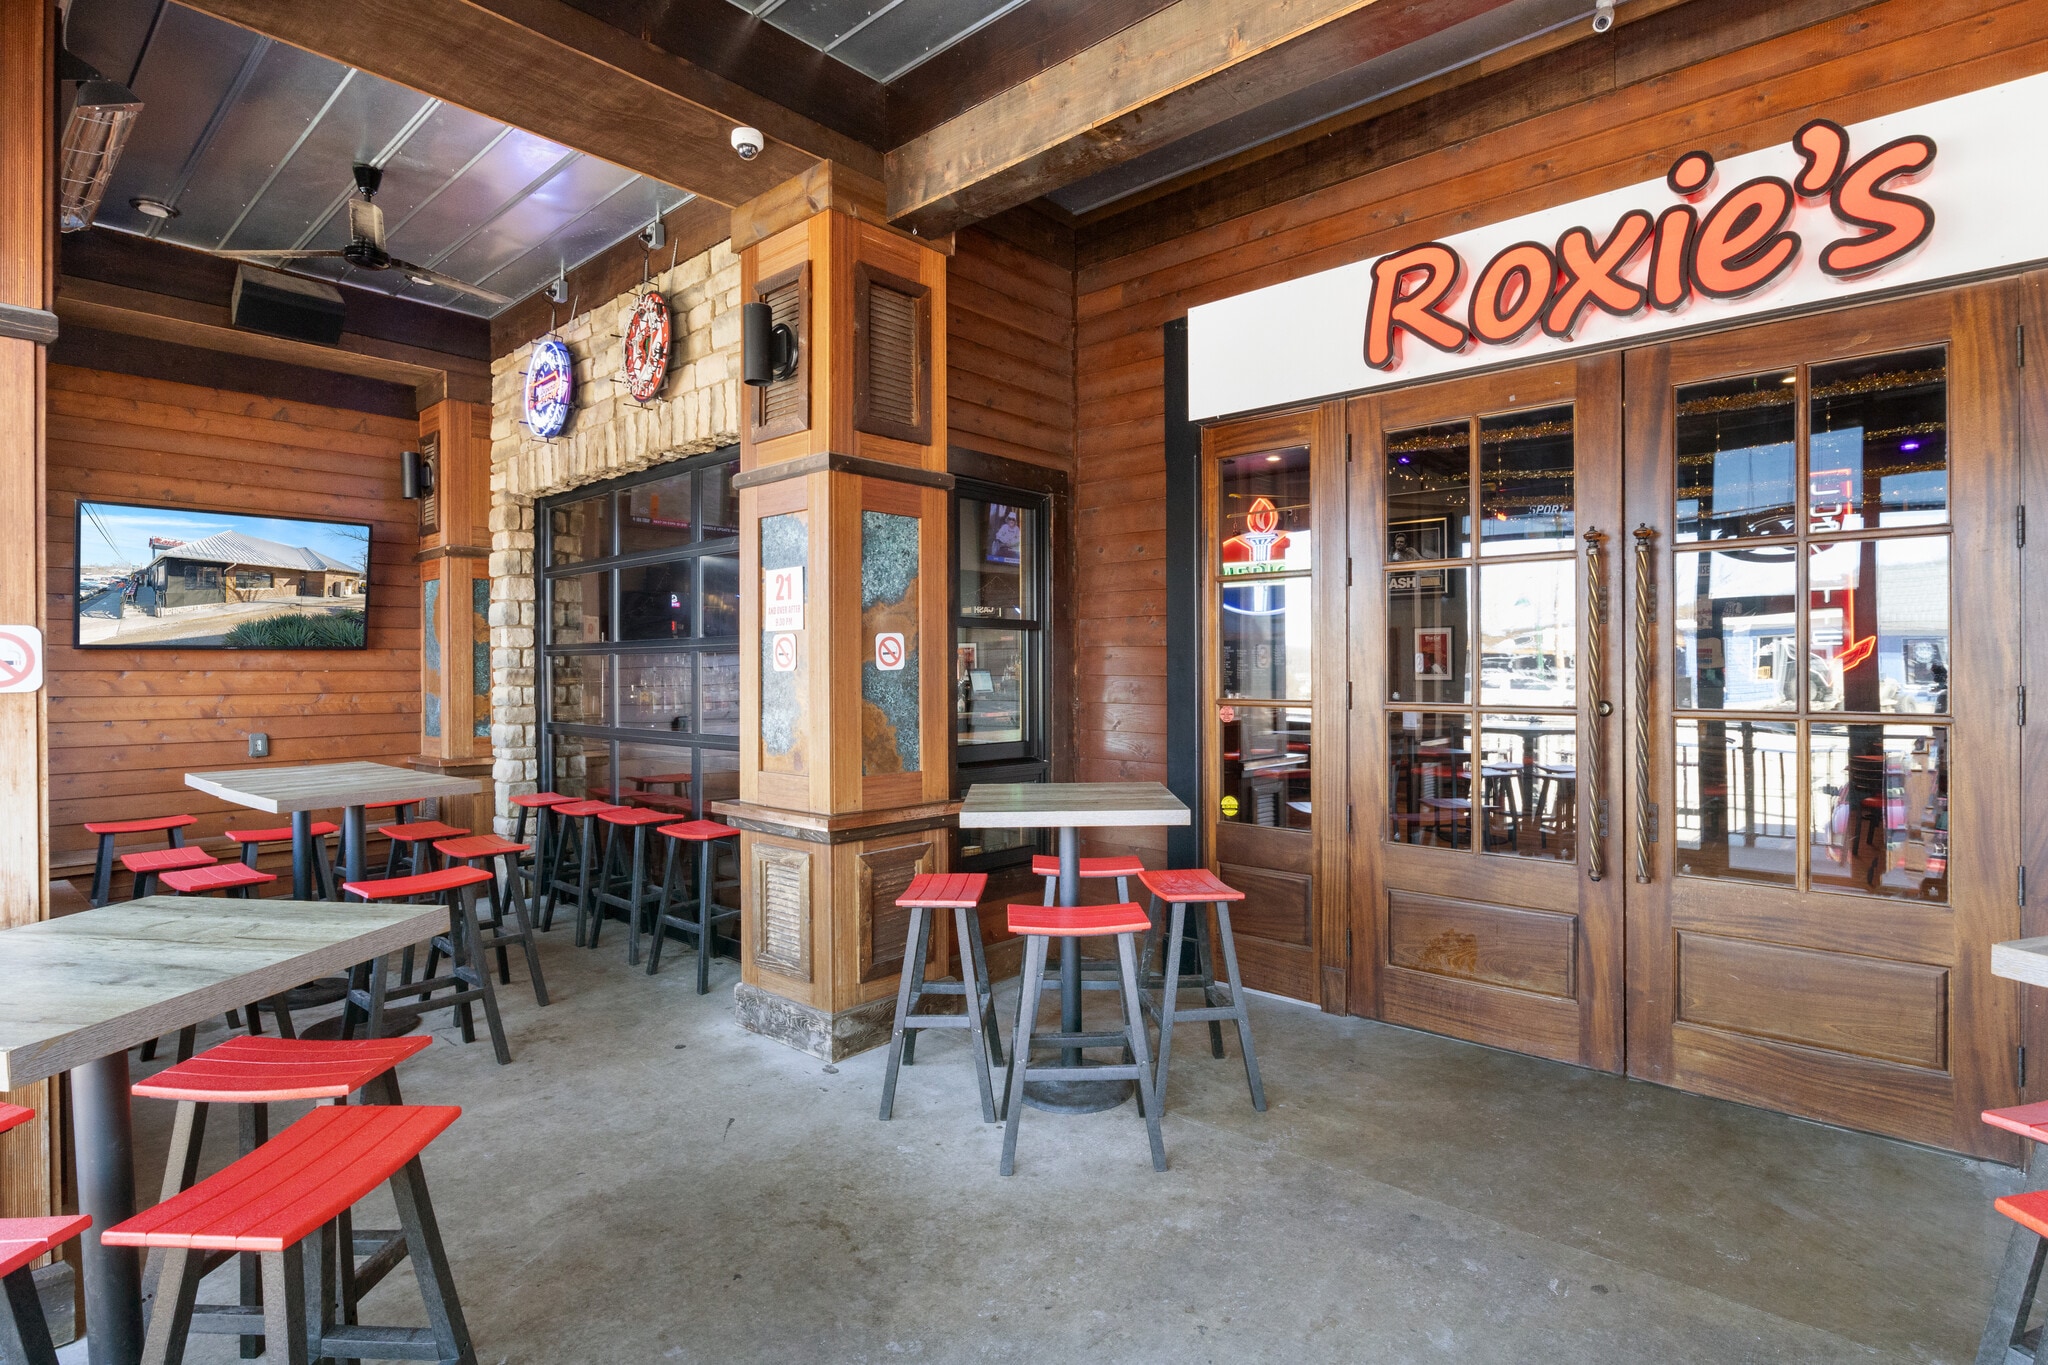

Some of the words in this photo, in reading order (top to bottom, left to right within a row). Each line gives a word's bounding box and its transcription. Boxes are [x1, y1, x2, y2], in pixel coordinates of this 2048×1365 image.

[1363, 118, 1937, 370] Roxie's
[776, 573, 792, 601] 21
[768, 607, 776, 615] AND
[777, 606, 787, 615] OVER
[788, 604, 801, 614] AFTER
